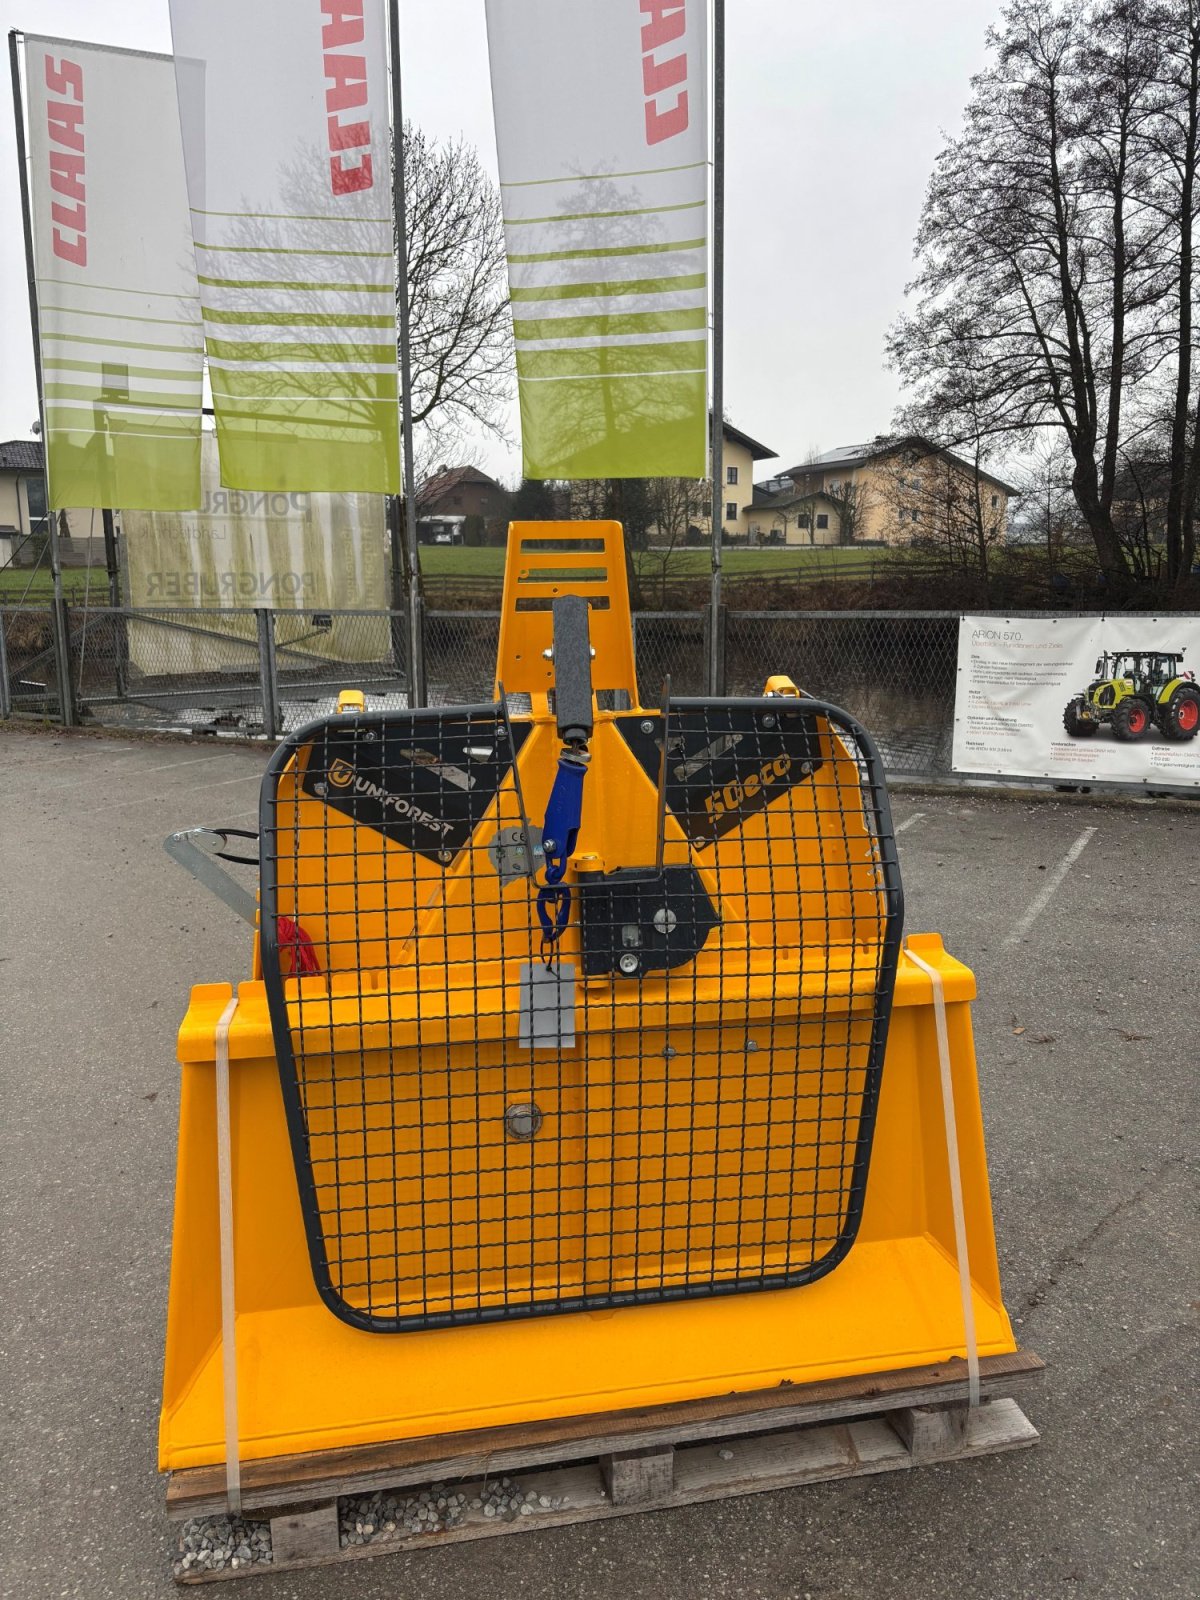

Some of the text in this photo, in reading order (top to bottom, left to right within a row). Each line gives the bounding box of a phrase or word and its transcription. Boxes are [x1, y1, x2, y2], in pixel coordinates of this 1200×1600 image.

[45, 54, 87, 267] CLAAS
[972, 630, 1001, 640] ARION
[703, 752, 792, 824] 50eco
